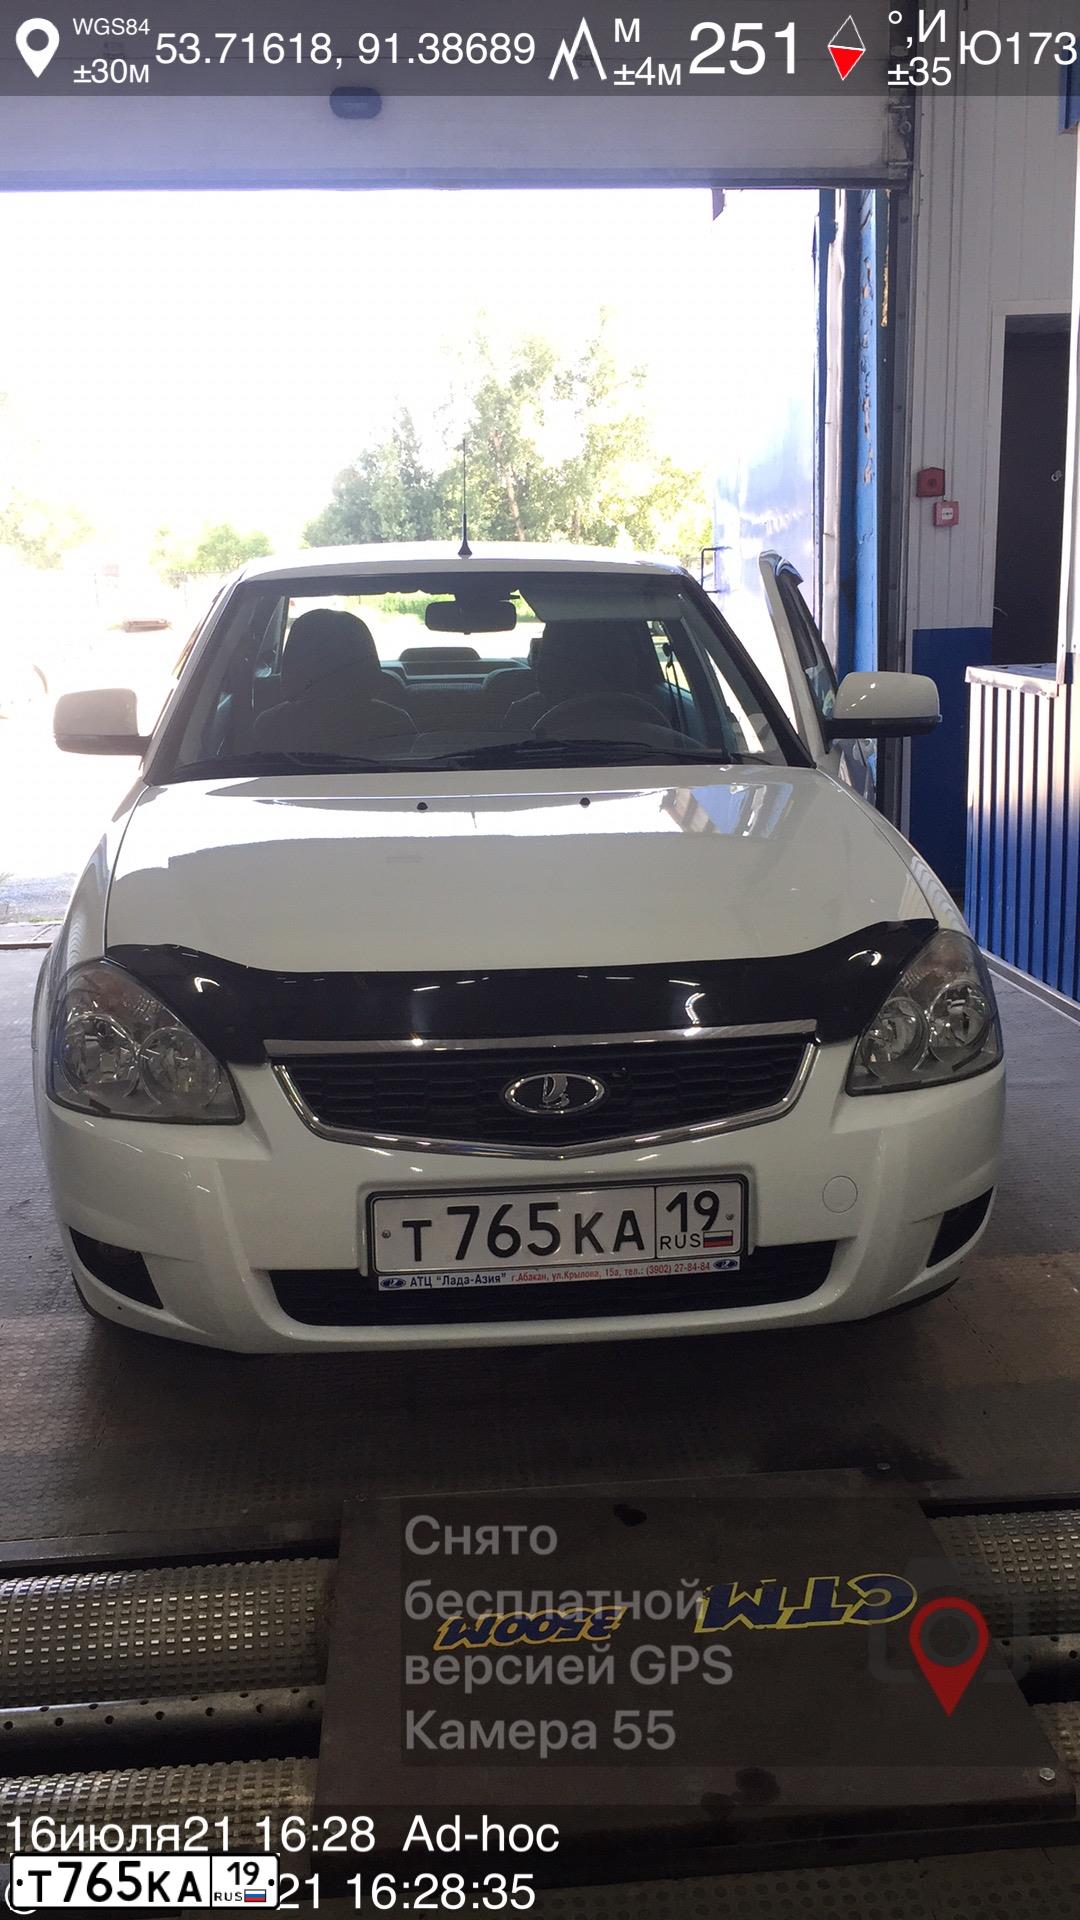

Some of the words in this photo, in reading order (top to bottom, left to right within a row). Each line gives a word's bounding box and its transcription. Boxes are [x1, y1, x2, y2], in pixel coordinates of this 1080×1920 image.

[665, 1190, 721, 1232] 19
[659, 1233, 701, 1251] RUS
[410, 1275, 432, 1288] АТЦ
[674, 1261, 711, 1274] 27-84-84
